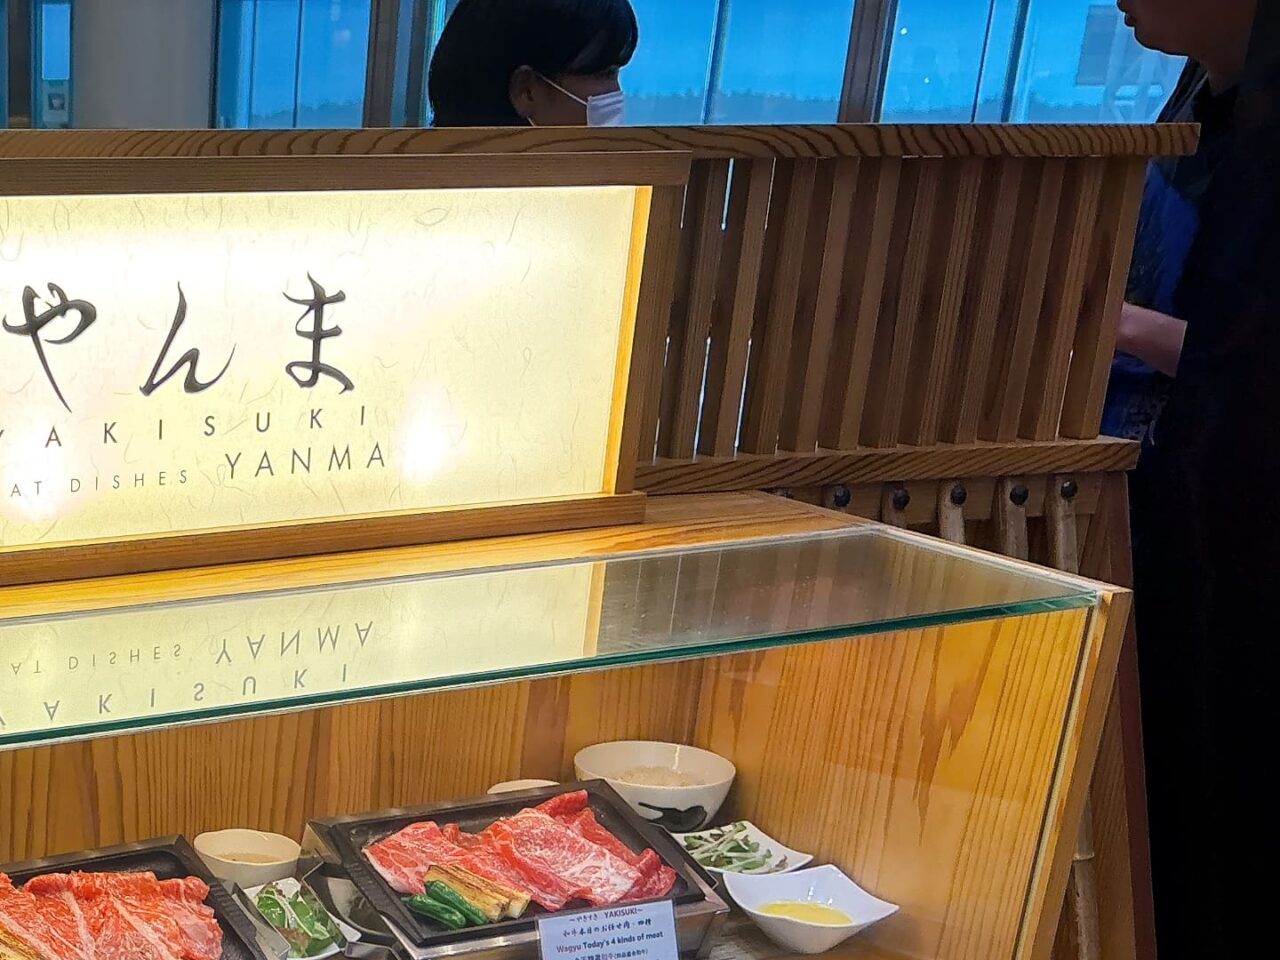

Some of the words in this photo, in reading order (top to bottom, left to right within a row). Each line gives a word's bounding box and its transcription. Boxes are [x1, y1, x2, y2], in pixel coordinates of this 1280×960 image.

[2, 270, 355, 414] やんま
[71, 469, 189, 493] DISHES
[225, 441, 388, 480] YANMA
[556, 945, 582, 953] Wagyu
[583, 940, 610, 949] Today's
[637, 933, 644, 941] of
